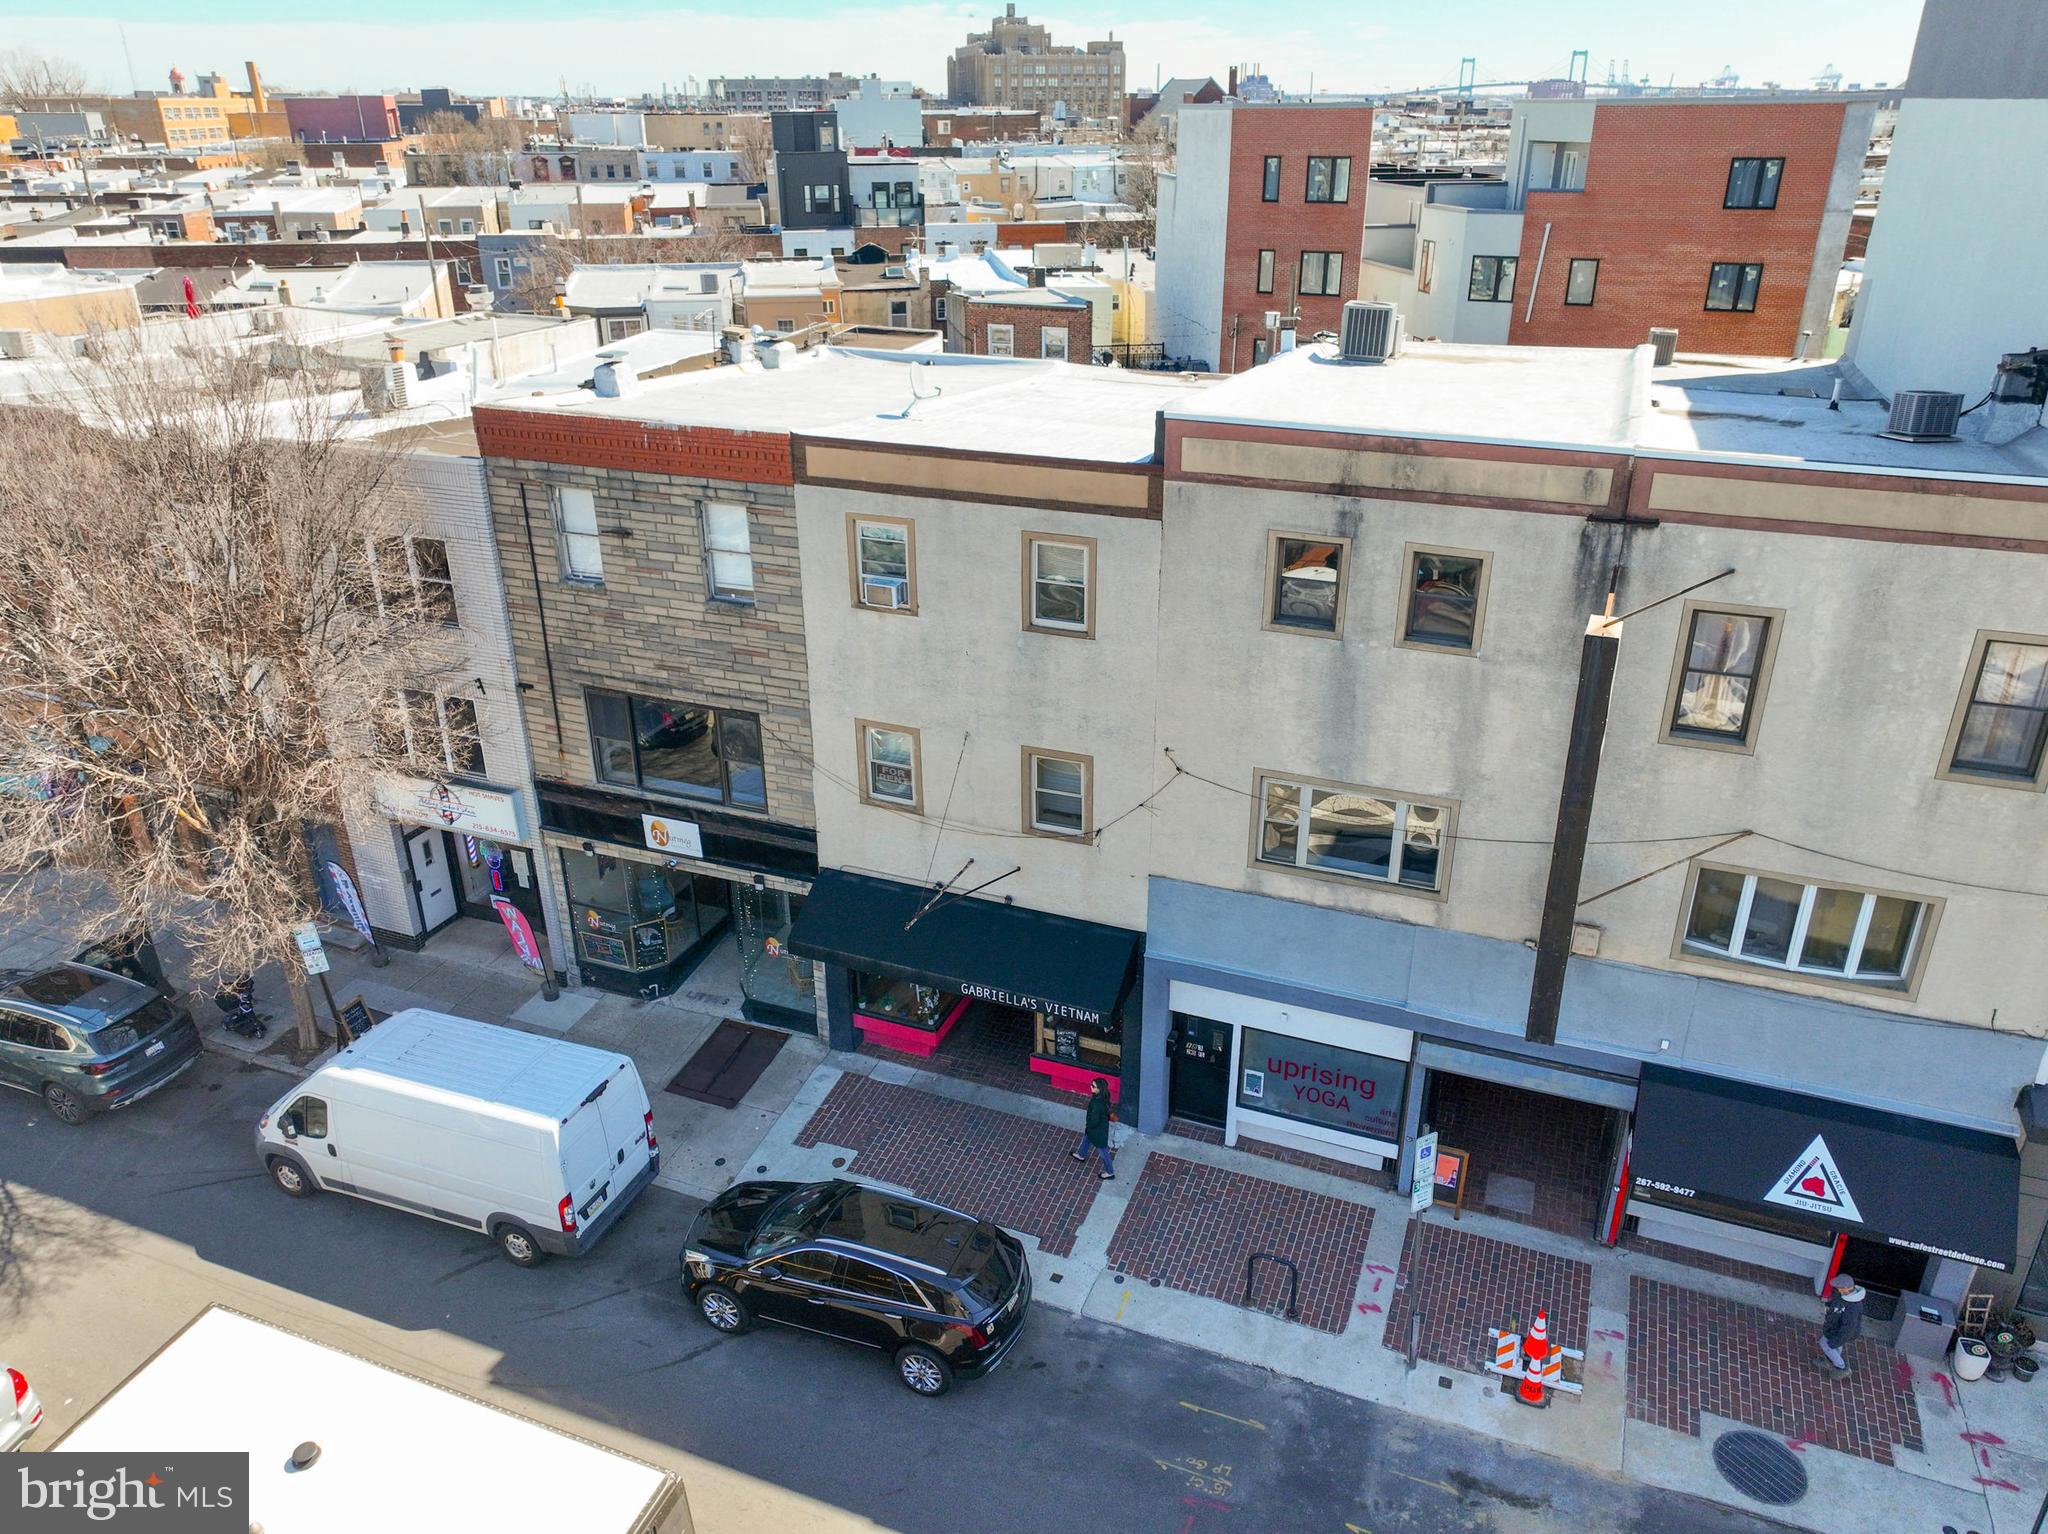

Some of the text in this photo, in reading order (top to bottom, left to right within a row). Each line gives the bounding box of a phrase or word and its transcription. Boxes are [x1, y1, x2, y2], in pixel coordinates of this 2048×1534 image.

[881, 766, 905, 777] FOR
[960, 983, 1037, 1010] GABRIELLA'S
[1045, 1001, 1100, 1024] VIETNAM
[1266, 1057, 1376, 1100] uprising
[1293, 1083, 1351, 1113] YOGA
[1364, 1114, 1397, 1129] culture
[1379, 1108, 1398, 1118] arts
[1346, 1120, 1396, 1138] movement
[1783, 1159, 1806, 1185] DIAMOND
[1829, 1170, 1846, 1195] GRACIE
[1635, 1176, 1696, 1197] 267-592-9477
[1888, 1236, 2006, 1270] www.safestreetdefense.com
